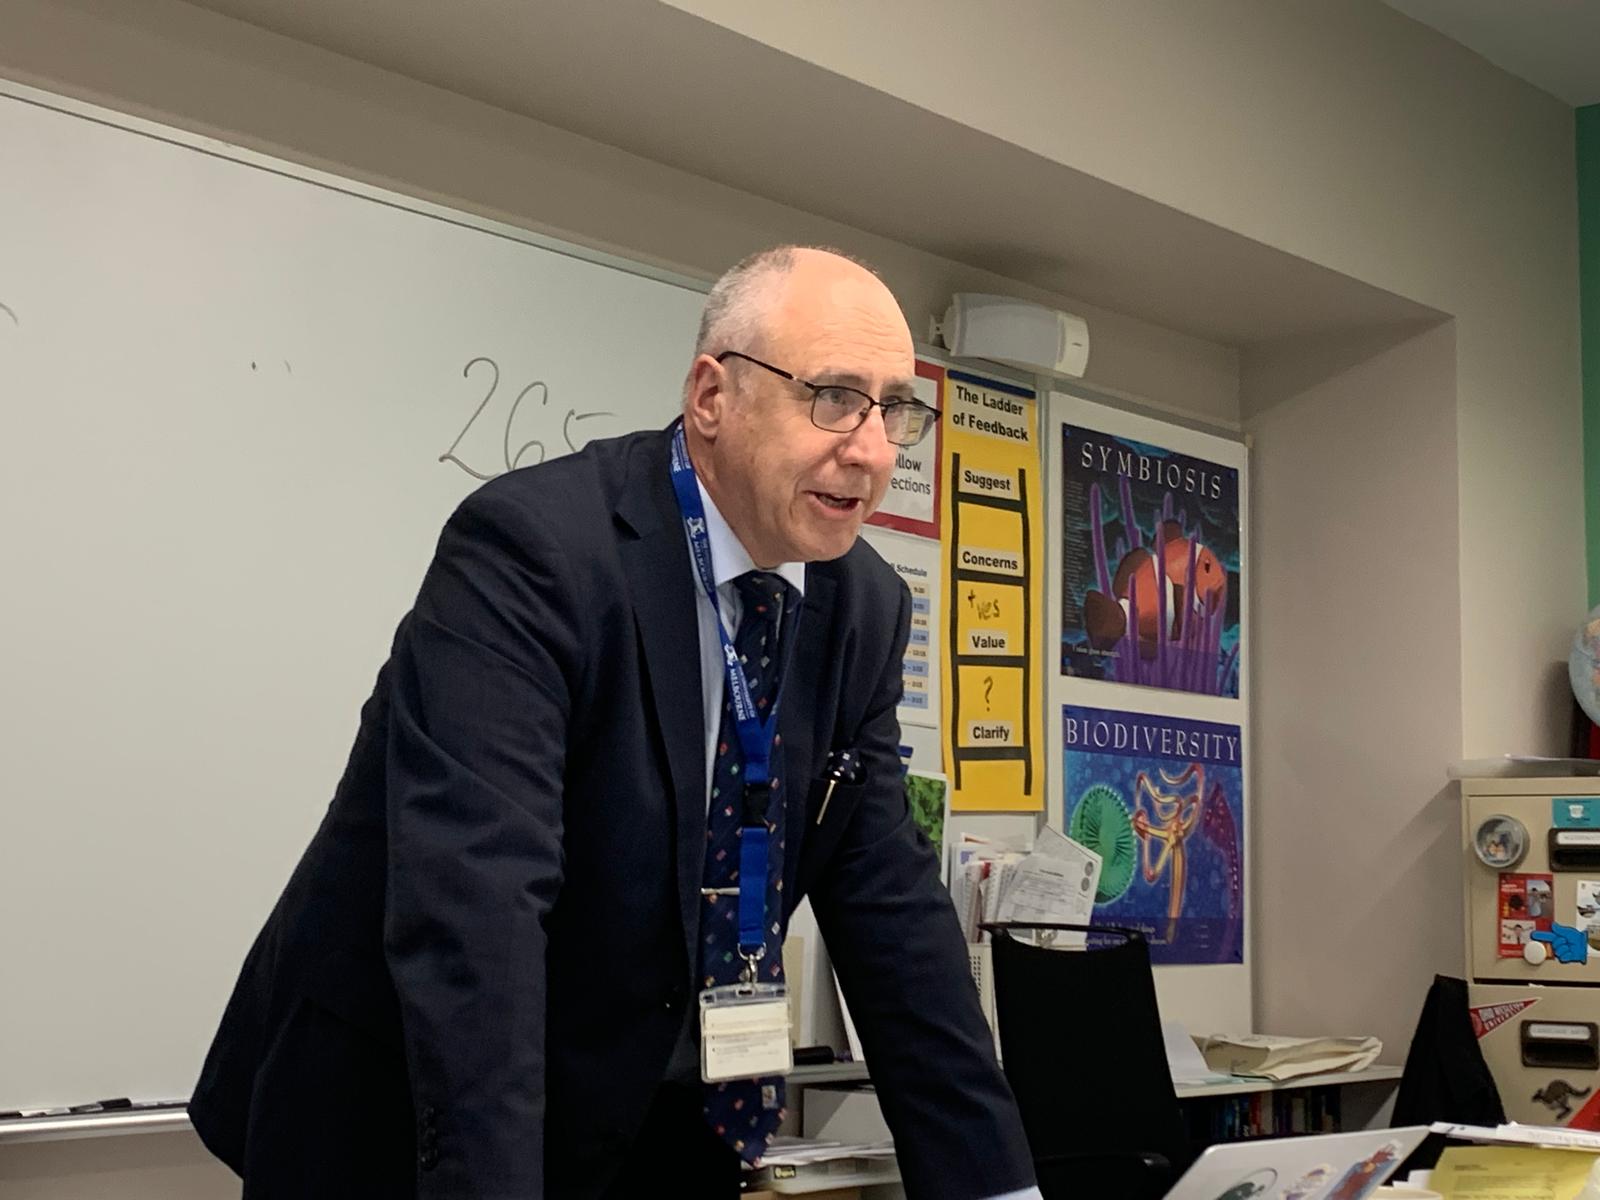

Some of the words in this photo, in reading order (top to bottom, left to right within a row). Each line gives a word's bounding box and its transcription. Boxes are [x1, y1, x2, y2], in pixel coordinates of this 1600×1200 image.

[956, 385, 979, 404] The
[983, 393, 1023, 416] Ladder
[953, 412, 965, 425] of
[969, 415, 1029, 441] Feedback
[896, 453, 921, 471] llow
[1081, 441, 1221, 499] SYMBIOSIS
[964, 470, 1011, 491] Suggest
[963, 551, 1018, 570] Concerns
[972, 635, 1005, 648] Value
[973, 726, 1010, 741] Clarify
[1066, 717, 1238, 761] BIODIVERSITY
